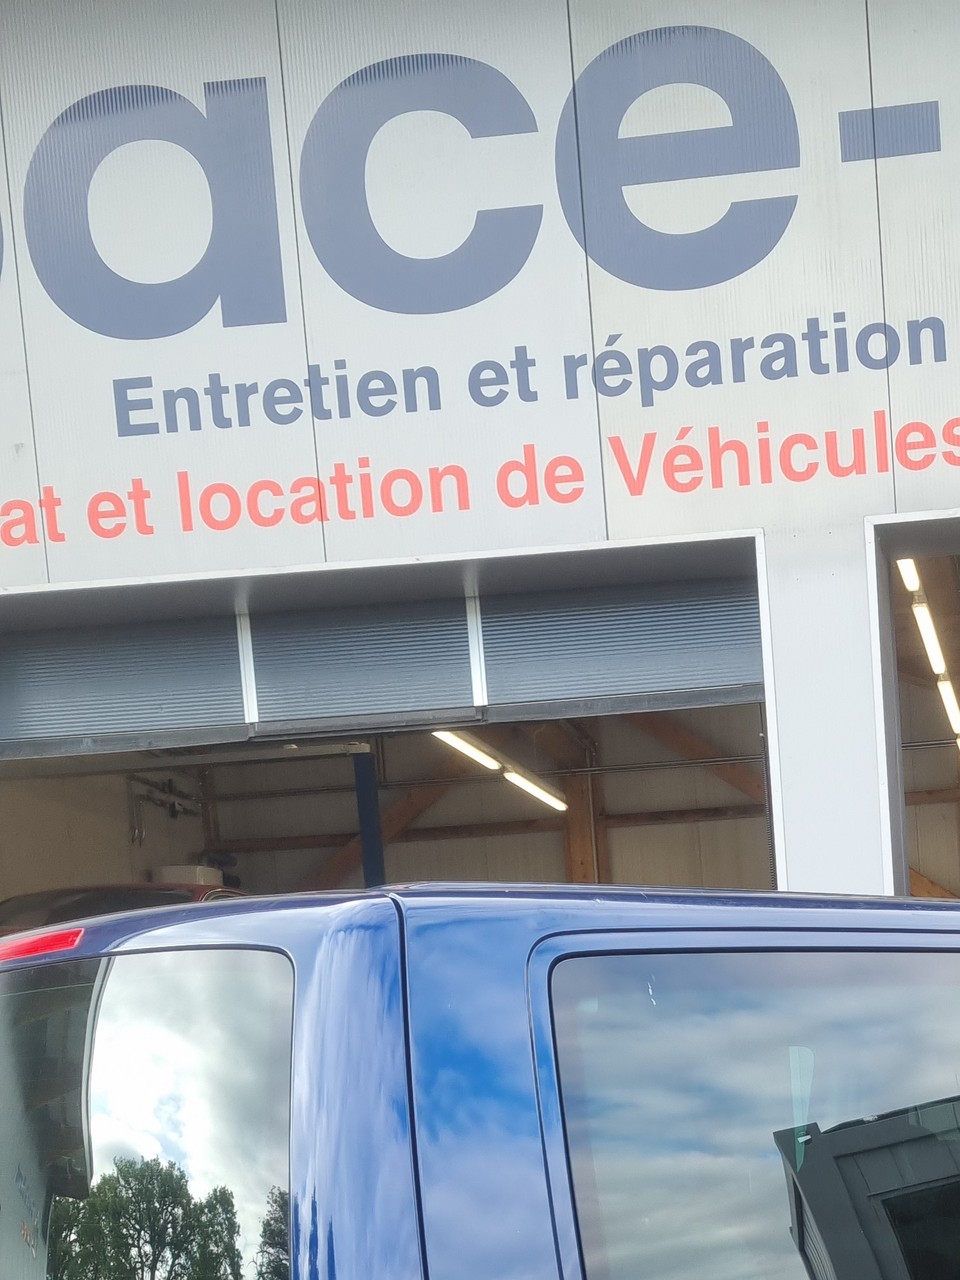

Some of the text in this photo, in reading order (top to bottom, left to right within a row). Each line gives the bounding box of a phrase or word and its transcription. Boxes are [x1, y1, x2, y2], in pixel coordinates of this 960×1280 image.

[114, 364, 441, 438] Entretien
[468, 346, 538, 407] et
[563, 318, 947, 407] réparation
[0, 487, 66, 547] at
[87, 479, 155, 539] et
[178, 463, 471, 532] location
[497, 444, 584, 508] de
